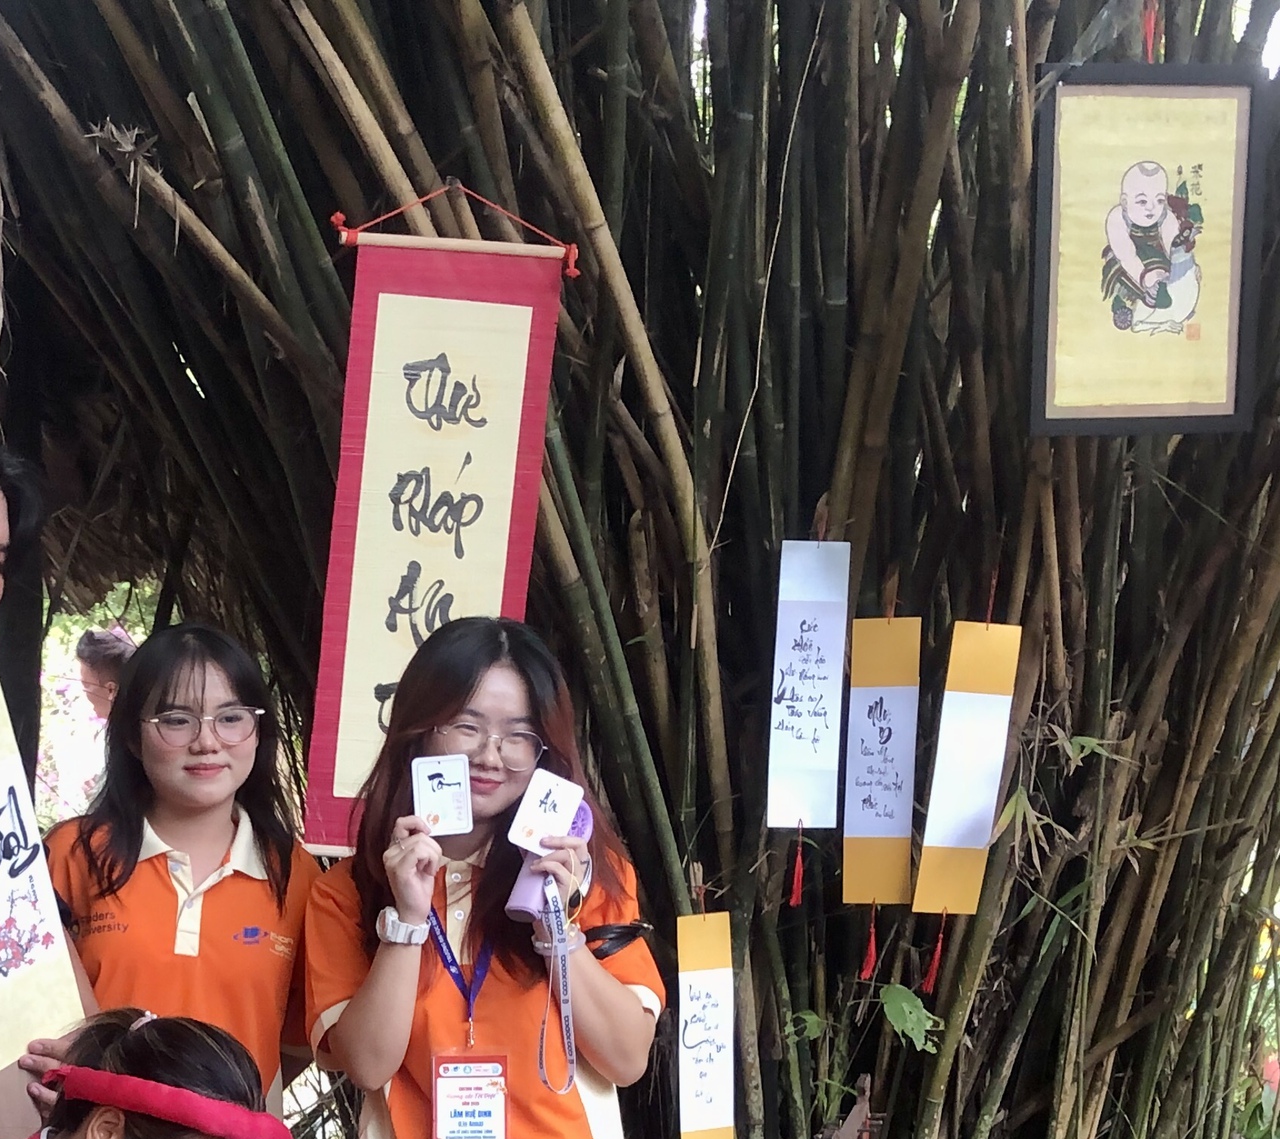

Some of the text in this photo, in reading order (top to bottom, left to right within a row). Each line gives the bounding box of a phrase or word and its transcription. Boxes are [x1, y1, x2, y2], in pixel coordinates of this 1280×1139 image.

[389, 452, 483, 559] Pháp
[385, 560, 454, 650] An
[82, 922, 129, 935] versity
